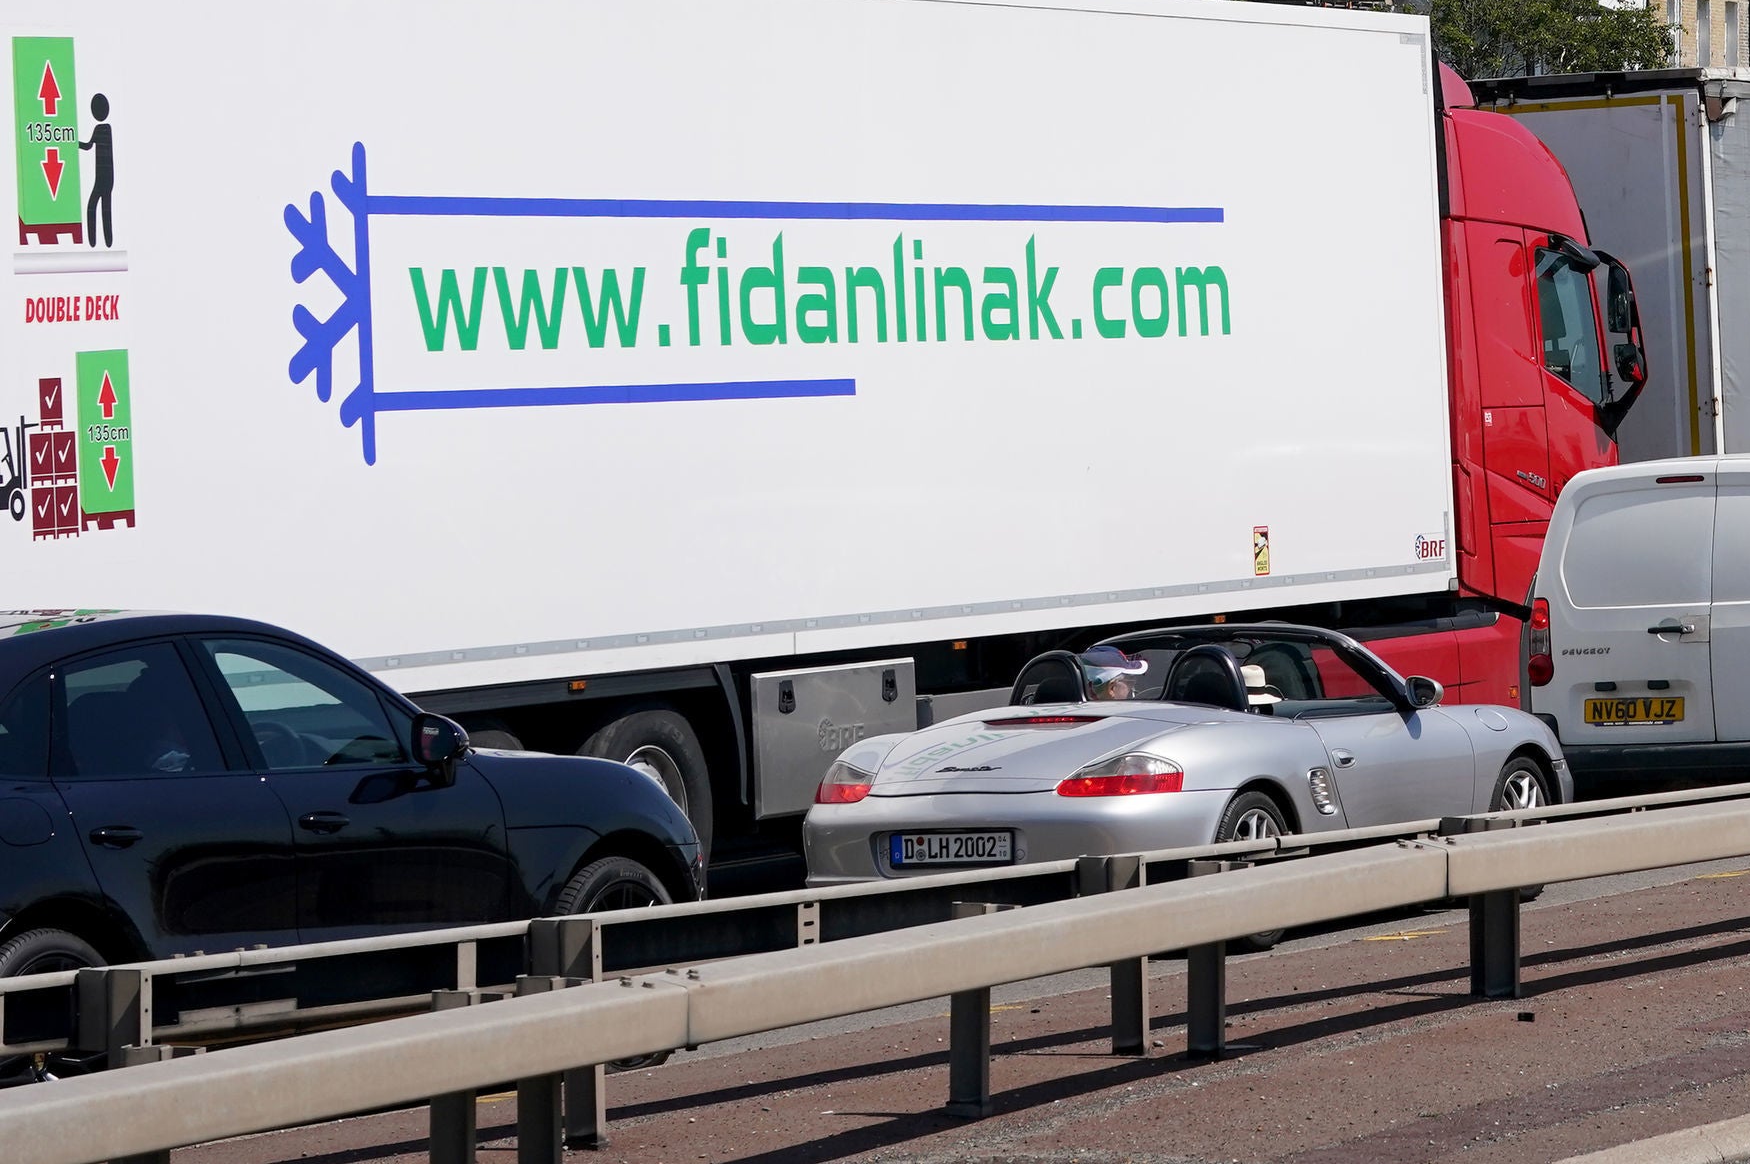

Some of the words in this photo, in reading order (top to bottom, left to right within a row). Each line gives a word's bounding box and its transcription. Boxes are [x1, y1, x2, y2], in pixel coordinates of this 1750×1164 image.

[26, 123, 75, 142] 135cm
[408, 227, 1232, 352] www.fidanlinak.com
[25, 296, 80, 323] DOUBLE
[85, 295, 119, 321] DECK
[88, 424, 129, 441] 135cm
[1421, 539, 1445, 559] BRF
[1562, 646, 1611, 656] PEUGEOT
[1592, 700, 1637, 720] NV60
[1643, 699, 1677, 719] VJZ
